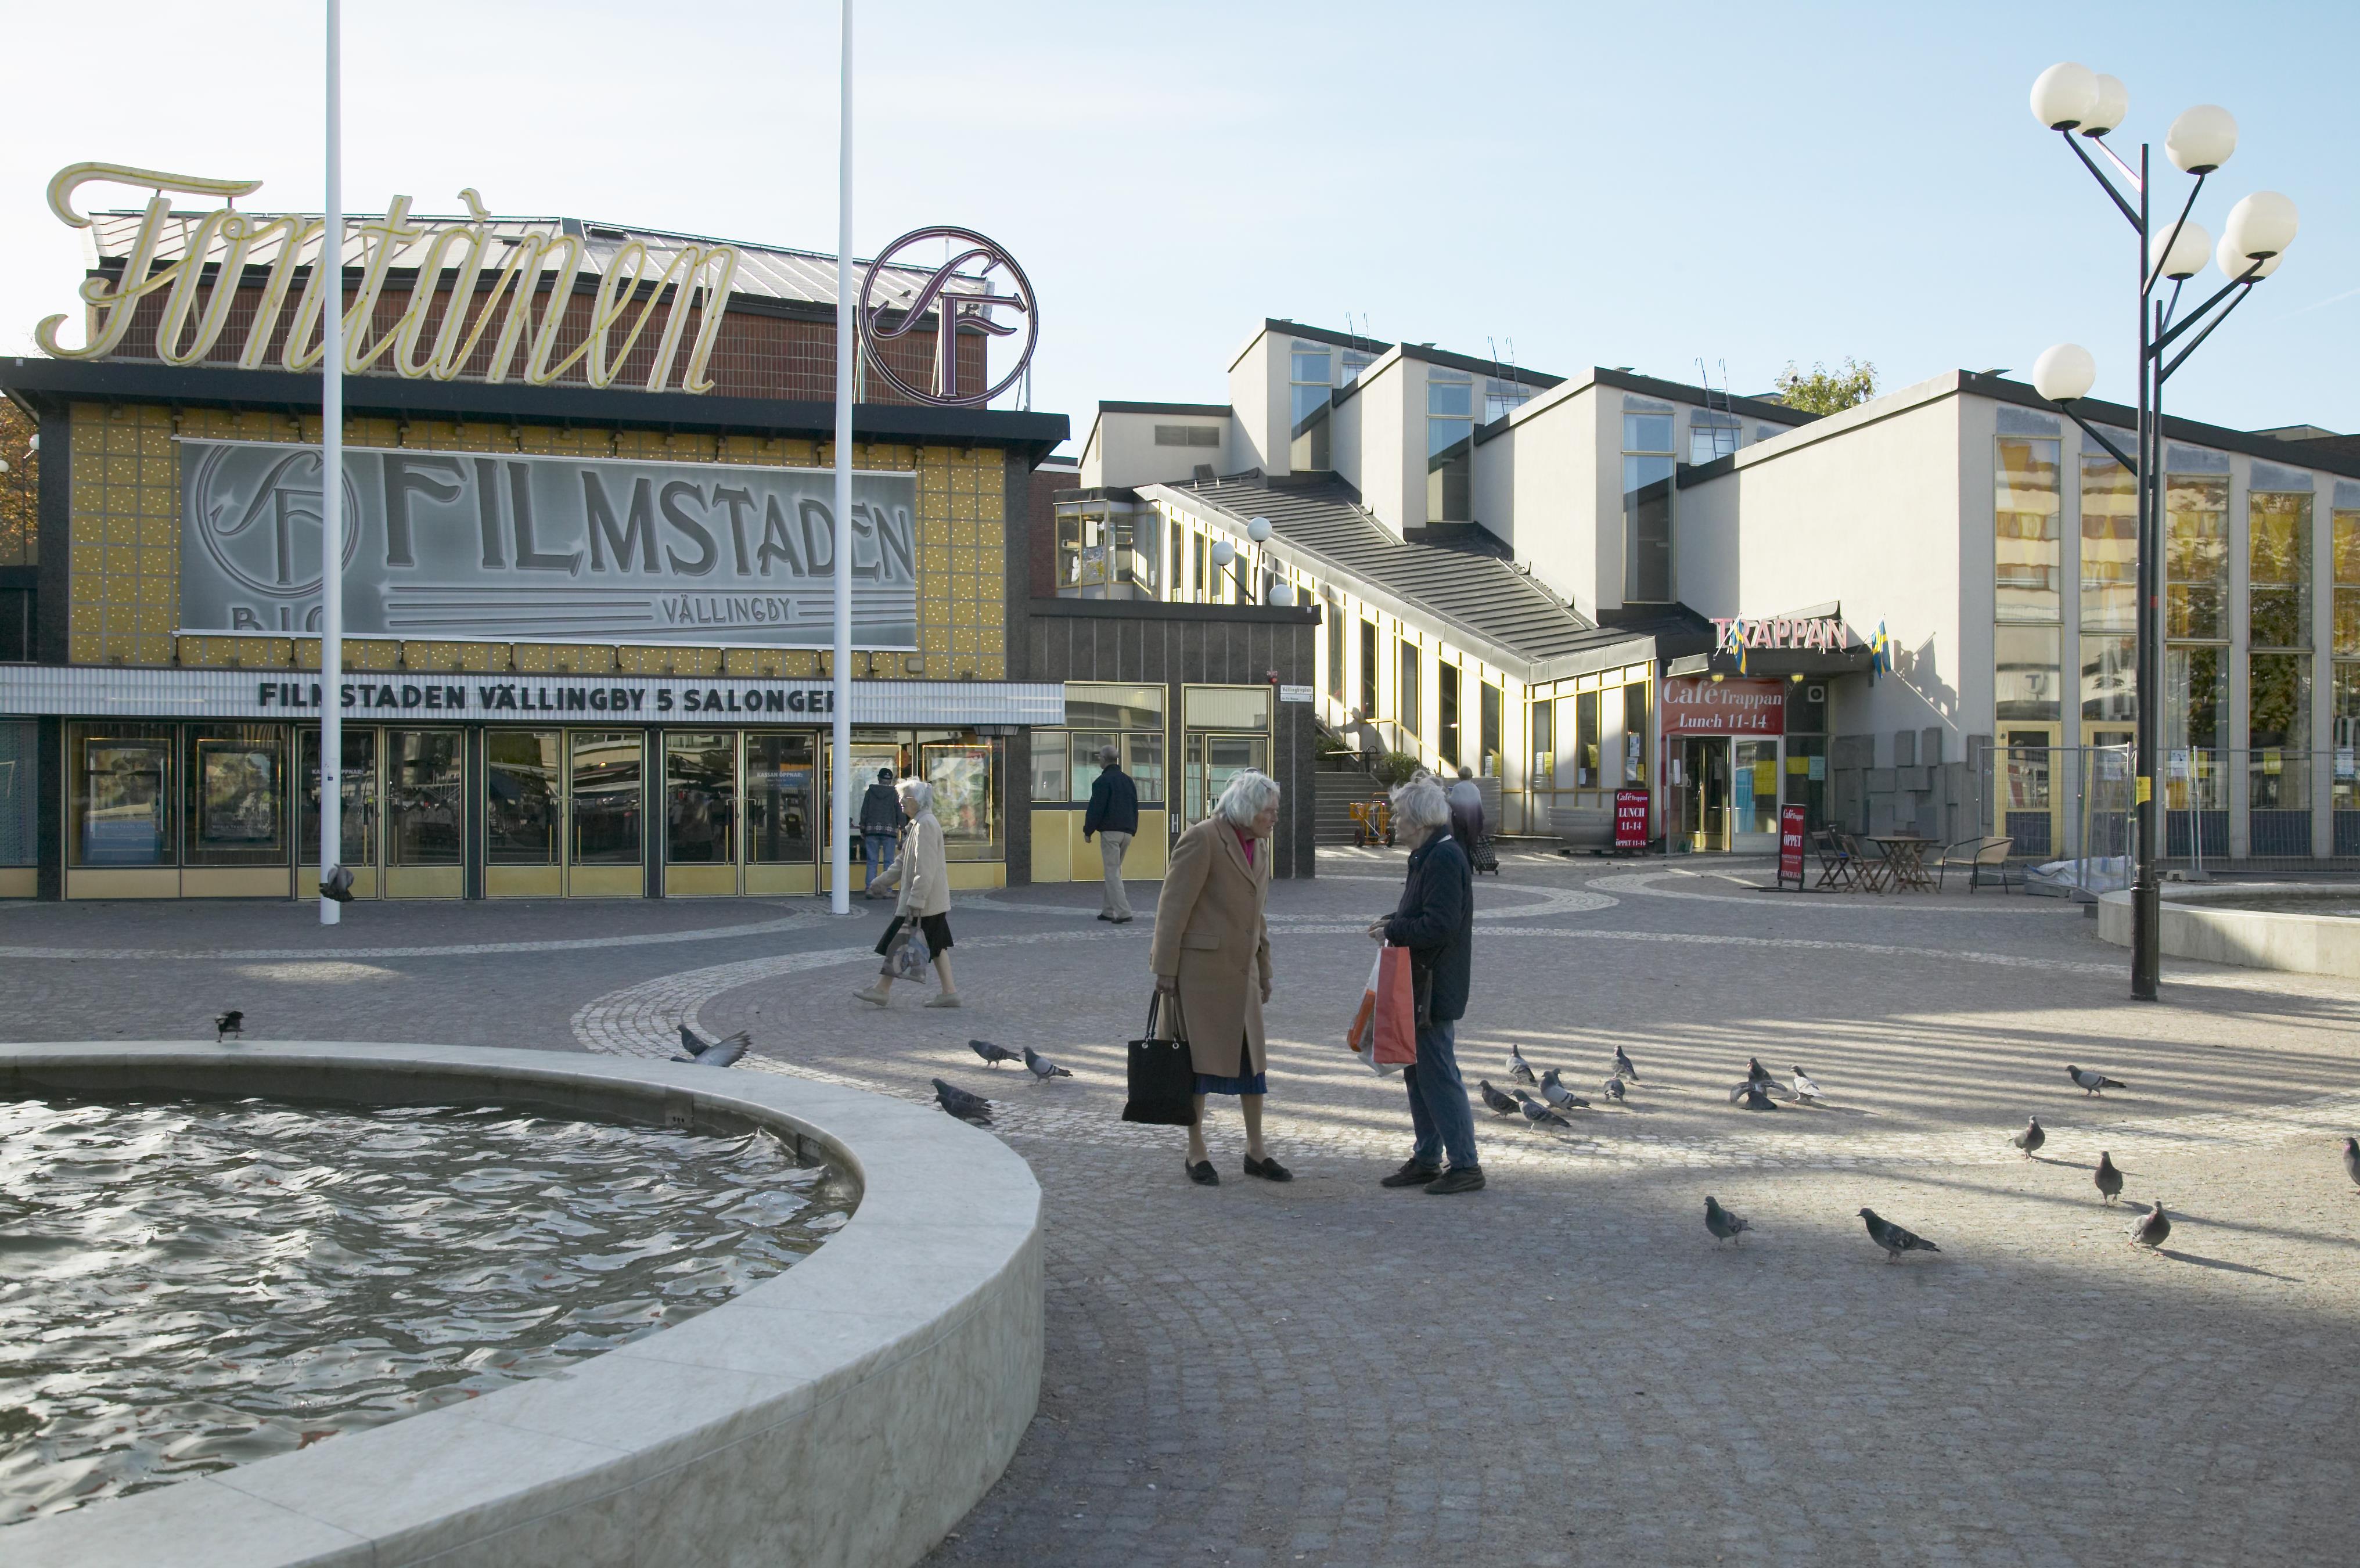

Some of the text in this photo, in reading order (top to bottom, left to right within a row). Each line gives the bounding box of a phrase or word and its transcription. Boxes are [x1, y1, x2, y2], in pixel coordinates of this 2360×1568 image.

[381, 452, 916, 582] FILMSTADEN
[661, 594, 790, 624] VÄLLINGBY
[1709, 618, 1847, 649] TRAPPAN
[479, 684, 646, 711] VÄLLINGBY
[657, 689, 674, 711] 5
[1663, 679, 1782, 709] Café Trappan
[1679, 714, 1767, 728] Lunch 11-14
[1617, 792, 1632, 801] Café
[1618, 808, 1645, 818] LUNCH
[1622, 822, 1642, 830] 11-14
[1783, 831, 1802, 847] ÖPPET
